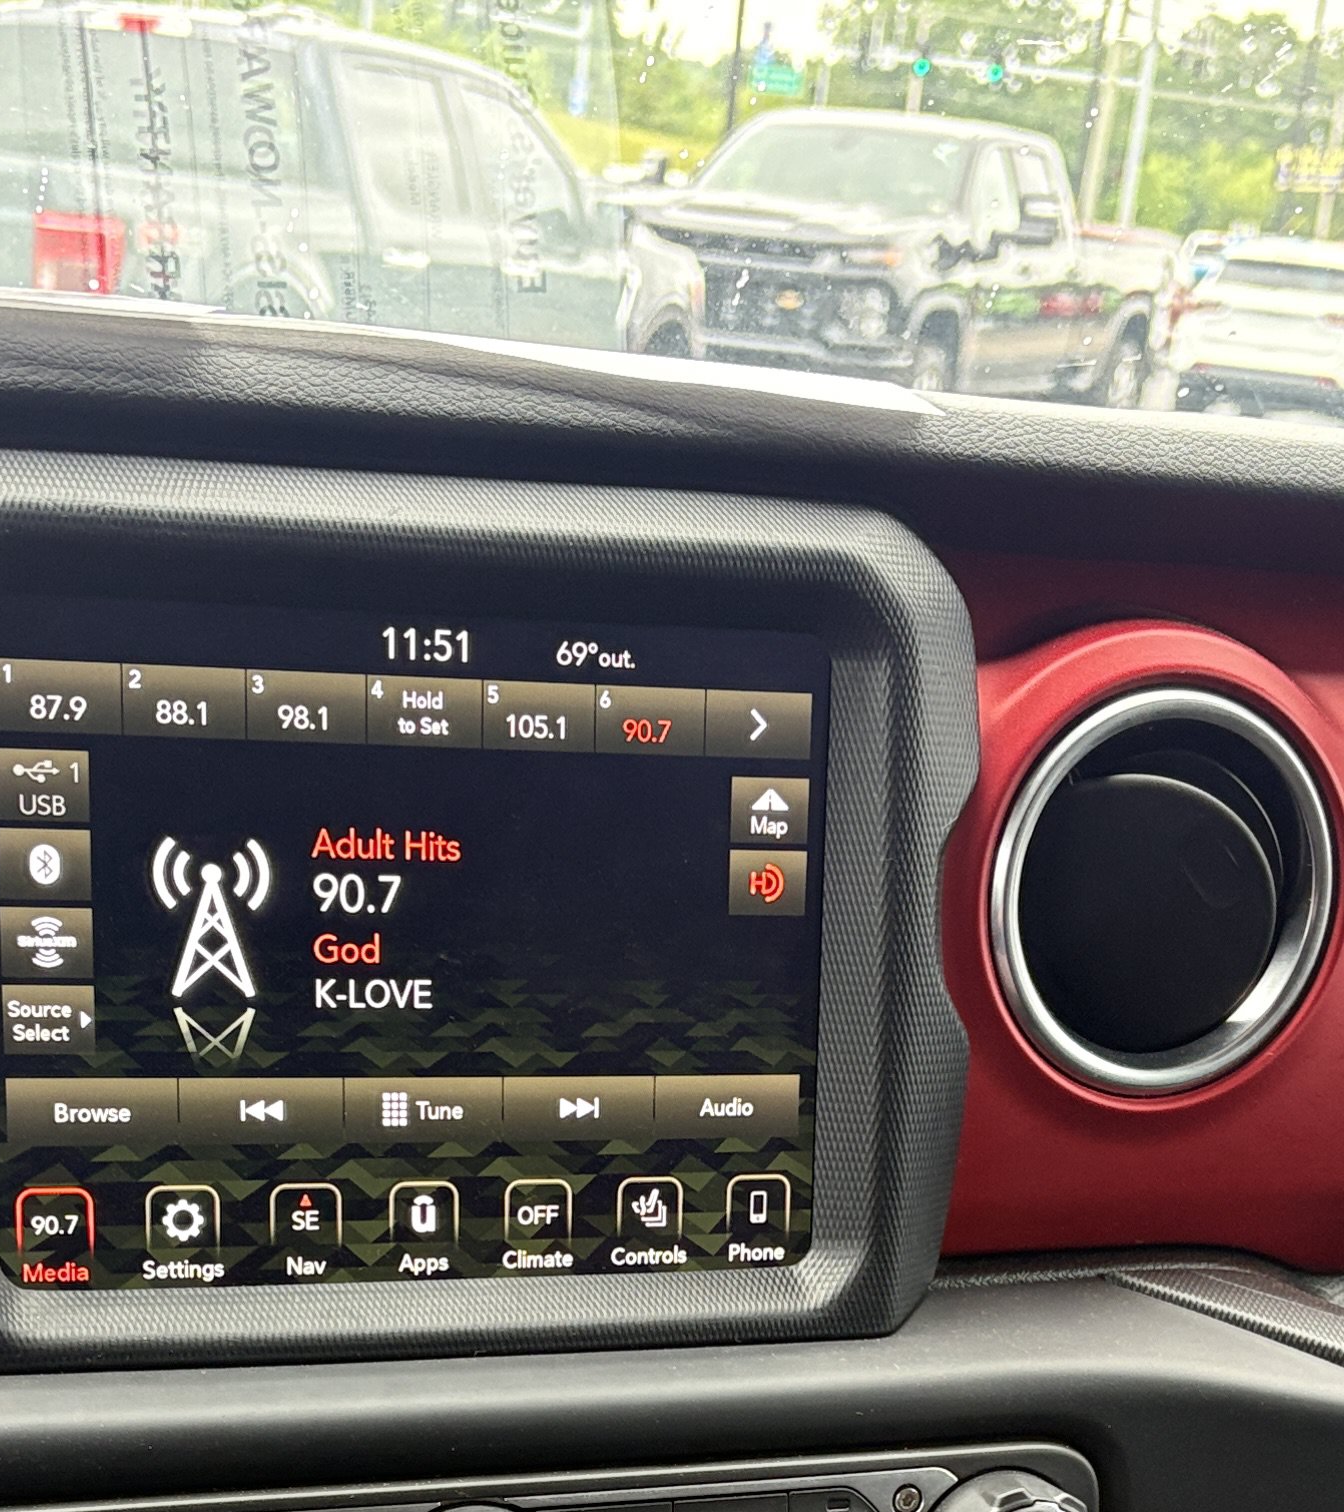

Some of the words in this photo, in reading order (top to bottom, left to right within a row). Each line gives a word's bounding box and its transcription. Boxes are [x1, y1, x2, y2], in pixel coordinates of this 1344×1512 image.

[382, 627, 470, 663] 11:51
[2, 665, 12, 683] 1
[128, 671, 142, 689] 2
[251, 675, 265, 694] 3
[370, 680, 384, 699] 4
[487, 685, 499, 704] 5
[599, 690, 612, 709] 6
[29, 695, 87, 721] 87.9
[402, 692, 443, 710] Hold
[155, 701, 207, 726] 88.1
[278, 705, 328, 731] 98.1
[397, 718, 416, 735] to
[419, 718, 449, 736] Set
[506, 714, 567, 739] 105.1
[622, 719, 672, 744] 90.7
[69, 762, 80, 783] 1
[19, 795, 66, 816] USB
[749, 817, 788, 838] Map
[311, 828, 395, 861] Adult
[403, 831, 462, 862] Hits
[312, 873, 402, 914] 90.7
[313, 933, 381, 963] God
[314, 978, 433, 1010] K-LOVE
[7, 1000, 72, 1019] Source
[12, 1024, 70, 1042] Select
[54, 1102, 132, 1124] Browse
[415, 1100, 464, 1120] Tune
[699, 1098, 754, 1118] Audio
[30, 1214, 79, 1236] 90.7
[291, 1210, 320, 1232] SE
[517, 1205, 559, 1226] OFF
[502, 1249, 574, 1270] Climate
[610, 1244, 687, 1267] Controls
[728, 1242, 785, 1263] Phone
[22, 1262, 90, 1284] Media
[142, 1260, 225, 1282] Settings
[286, 1255, 326, 1276] Nav
[398, 1253, 449, 1276] Apps
